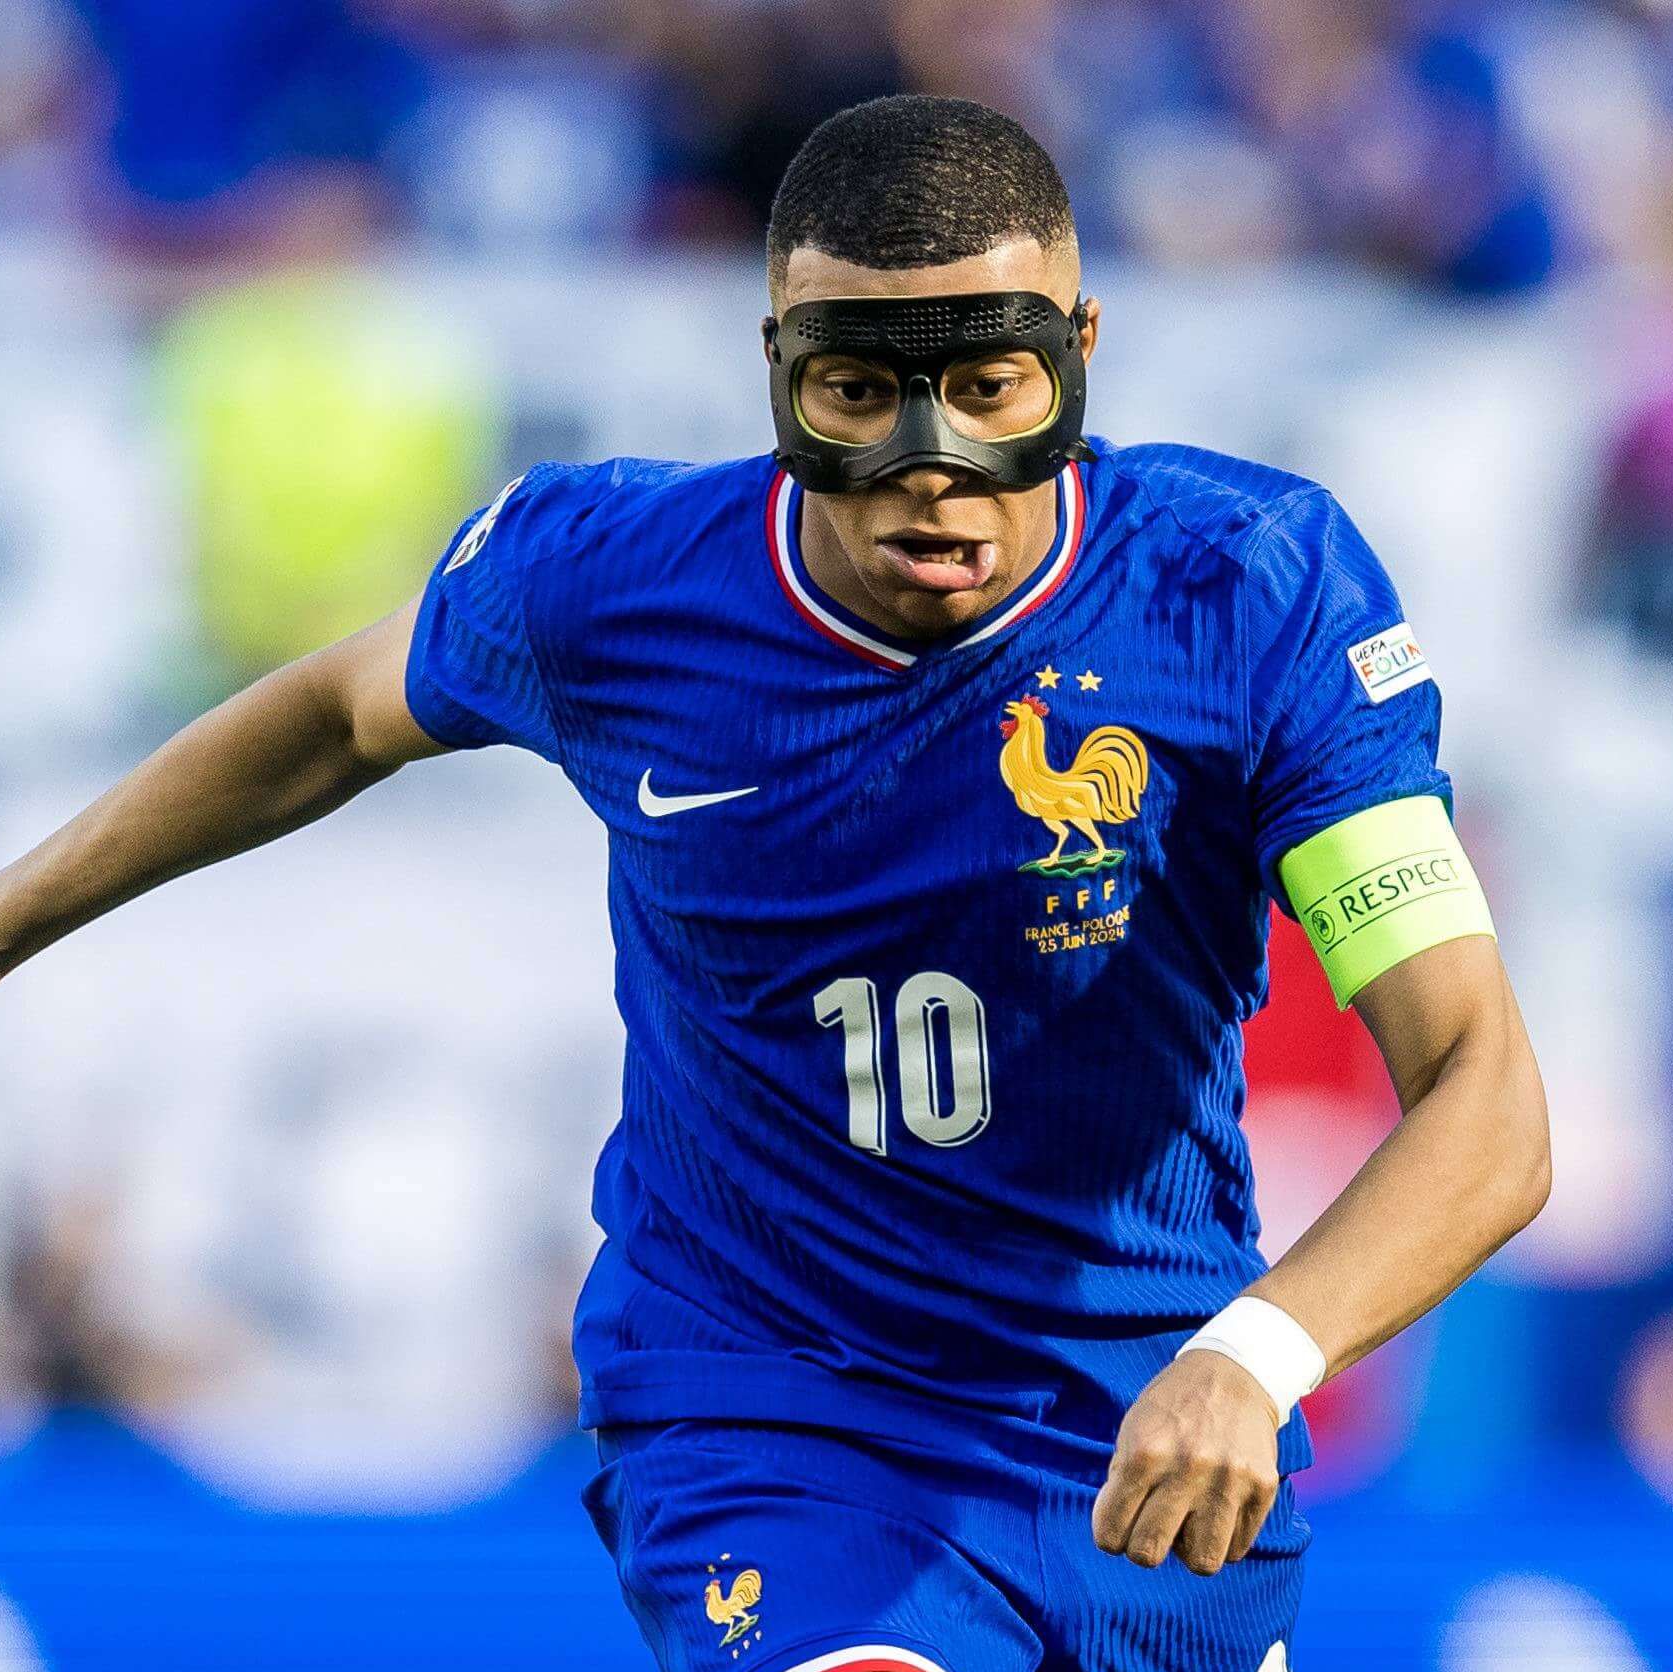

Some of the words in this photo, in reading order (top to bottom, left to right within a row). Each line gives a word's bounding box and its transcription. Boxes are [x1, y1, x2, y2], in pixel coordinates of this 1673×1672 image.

[1354, 639, 1387, 663] UEFA
[1339, 858, 1459, 923] RESPECT
[1025, 922, 1070, 941] FRANCE
[1039, 939, 1058, 953] 25
[1062, 933, 1086, 950] JUIN
[1089, 926, 1125, 945] 2024
[813, 971, 992, 1157] 10
